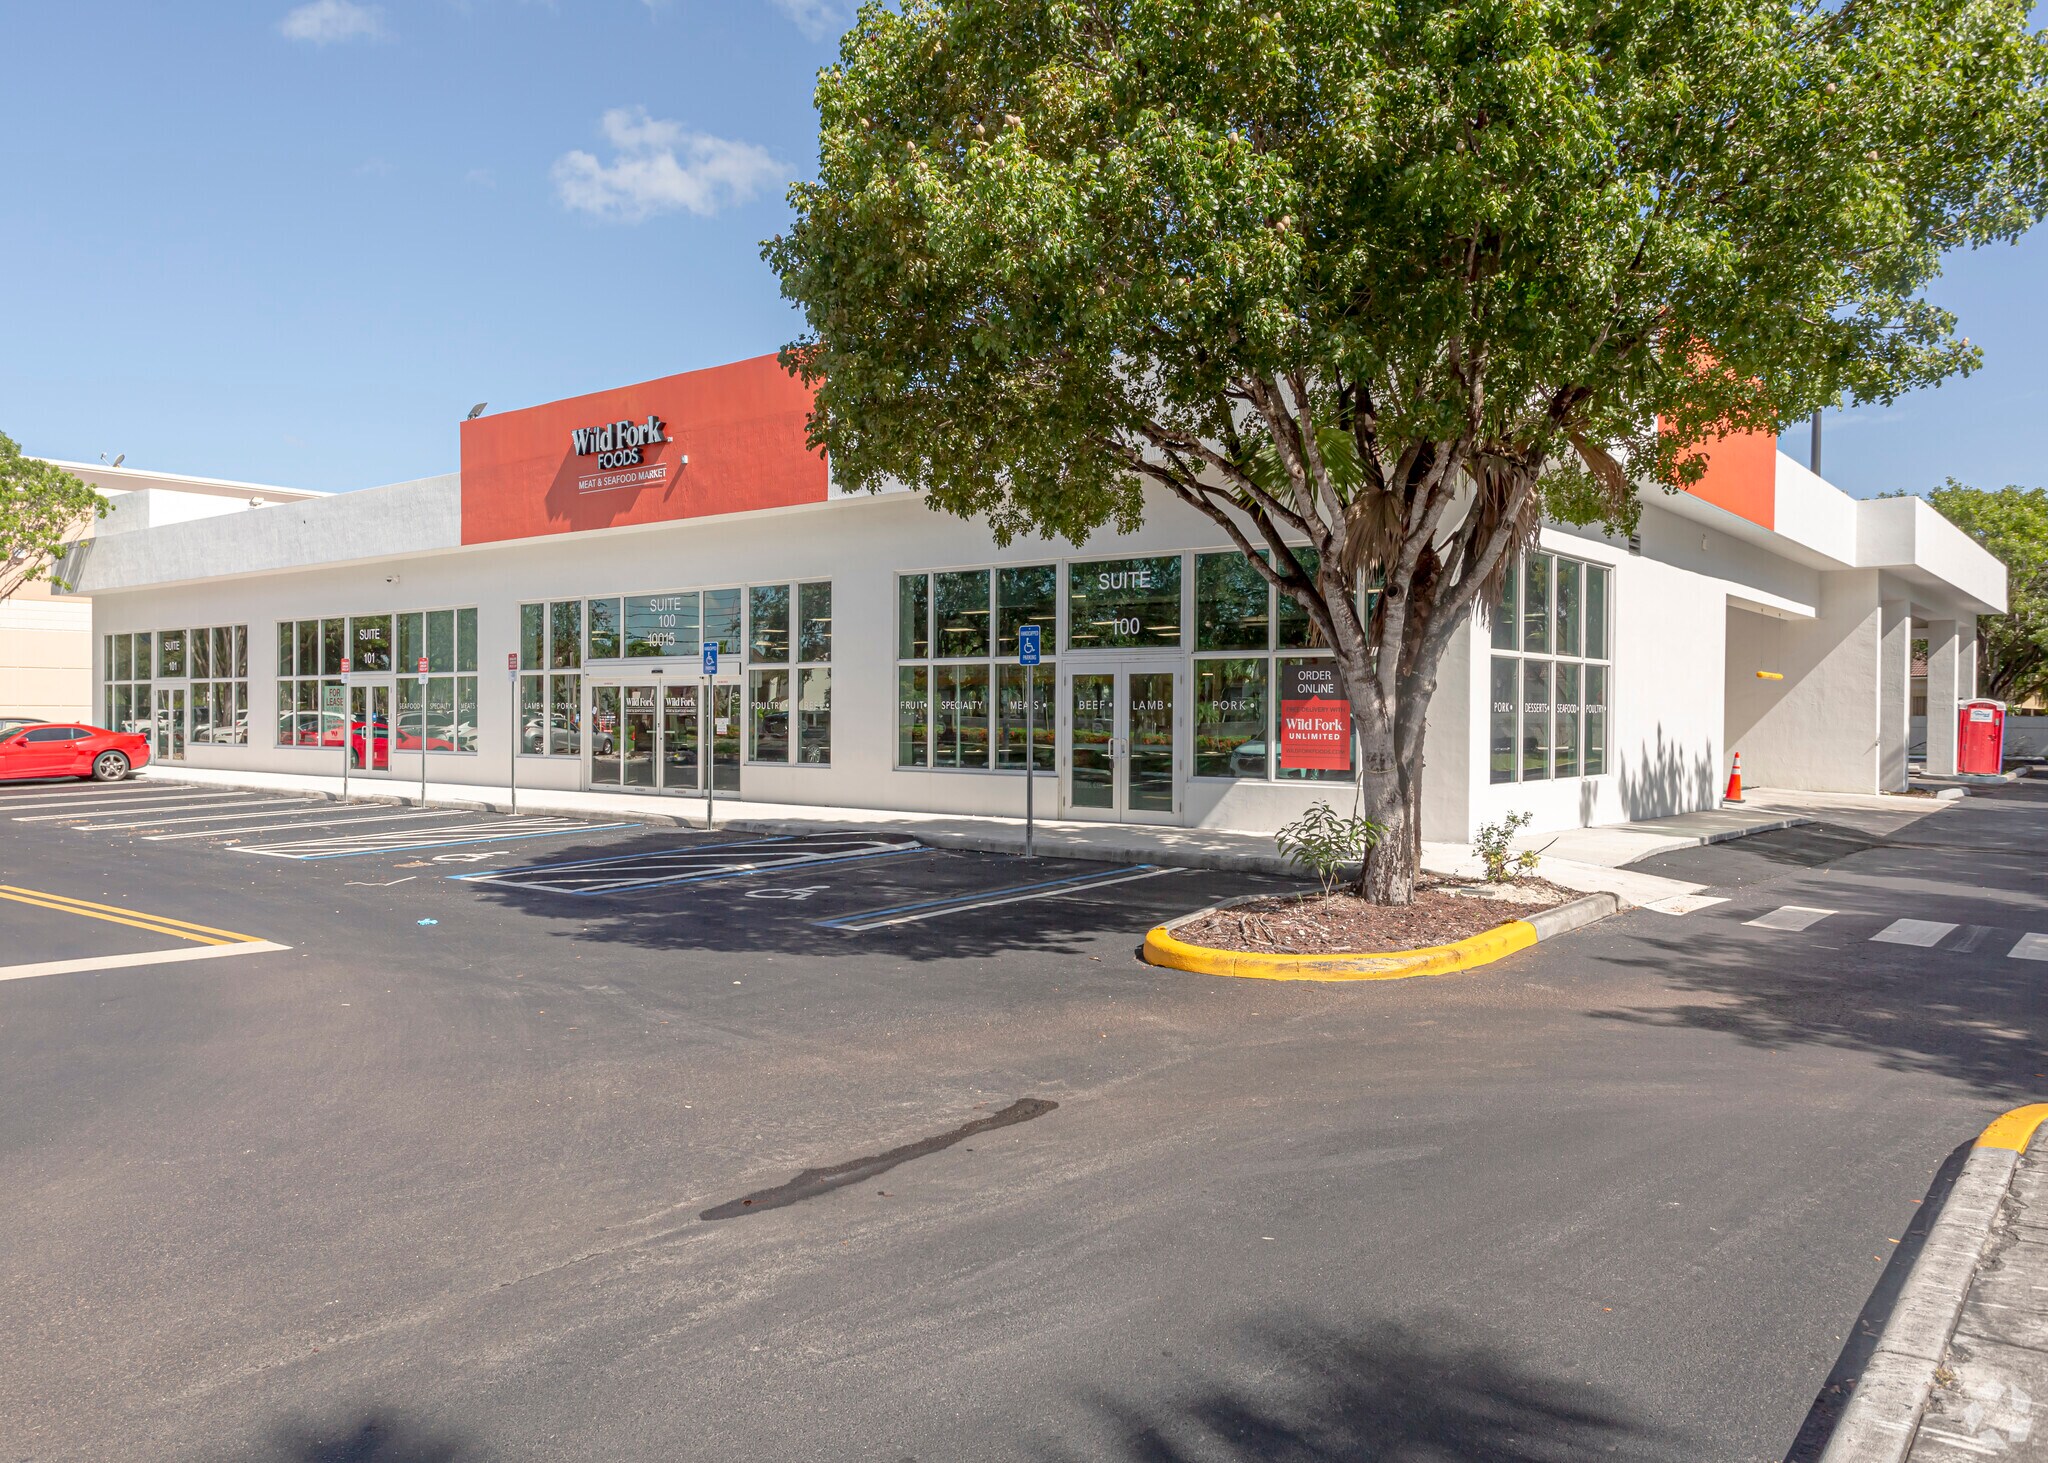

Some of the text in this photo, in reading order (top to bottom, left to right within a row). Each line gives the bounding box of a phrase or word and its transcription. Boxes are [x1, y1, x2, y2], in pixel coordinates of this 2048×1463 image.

[572, 415, 666, 456] Wild Fork
[598, 447, 643, 470] FOODS
[578, 467, 667, 490] MEAT & SEAFOOD MARKET
[1099, 570, 1151, 590] SUITE
[649, 597, 681, 612] SUITE
[658, 614, 676, 628] 100
[1112, 617, 1140, 635] 100
[359, 628, 381, 640] SUITE
[647, 632, 675, 647] 10015
[164, 640, 180, 651] SUITE
[363, 652, 375, 664] 101
[168, 661, 178, 671] 101
[1298, 670, 1332, 681] ORDER
[329, 688, 341, 697] FOR
[1297, 683, 1334, 694] ONLINE
[326, 697, 344, 707] LEASE
[399, 702, 420, 710] SEAFOOD
[429, 702, 451, 710] SPECIALTY
[460, 702, 475, 710] MEATS
[524, 702, 540, 710] LAMB
[556, 702, 574, 710] PORK
[625, 697, 655, 707] Wild Fork
[665, 697, 697, 707] Wild Fork
[751, 701, 782, 710] POULTRY
[900, 700, 924, 710] FRUIT
[941, 700, 983, 710] SPECIALTY
[1010, 700, 1039, 710] MEAS
[1078, 700, 1105, 711] BEEF
[1132, 700, 1164, 711] LAMB
[1212, 700, 1246, 711] PORK
[1493, 702, 1510, 713] PORK
[1524, 702, 1548, 713] DESSERTS
[1556, 703, 1577, 714] SEAFOOD
[1585, 704, 1604, 714] POULTRY
[1285, 718, 1343, 731] Wild Fork
[1289, 732, 1340, 741] UNLIMITED
